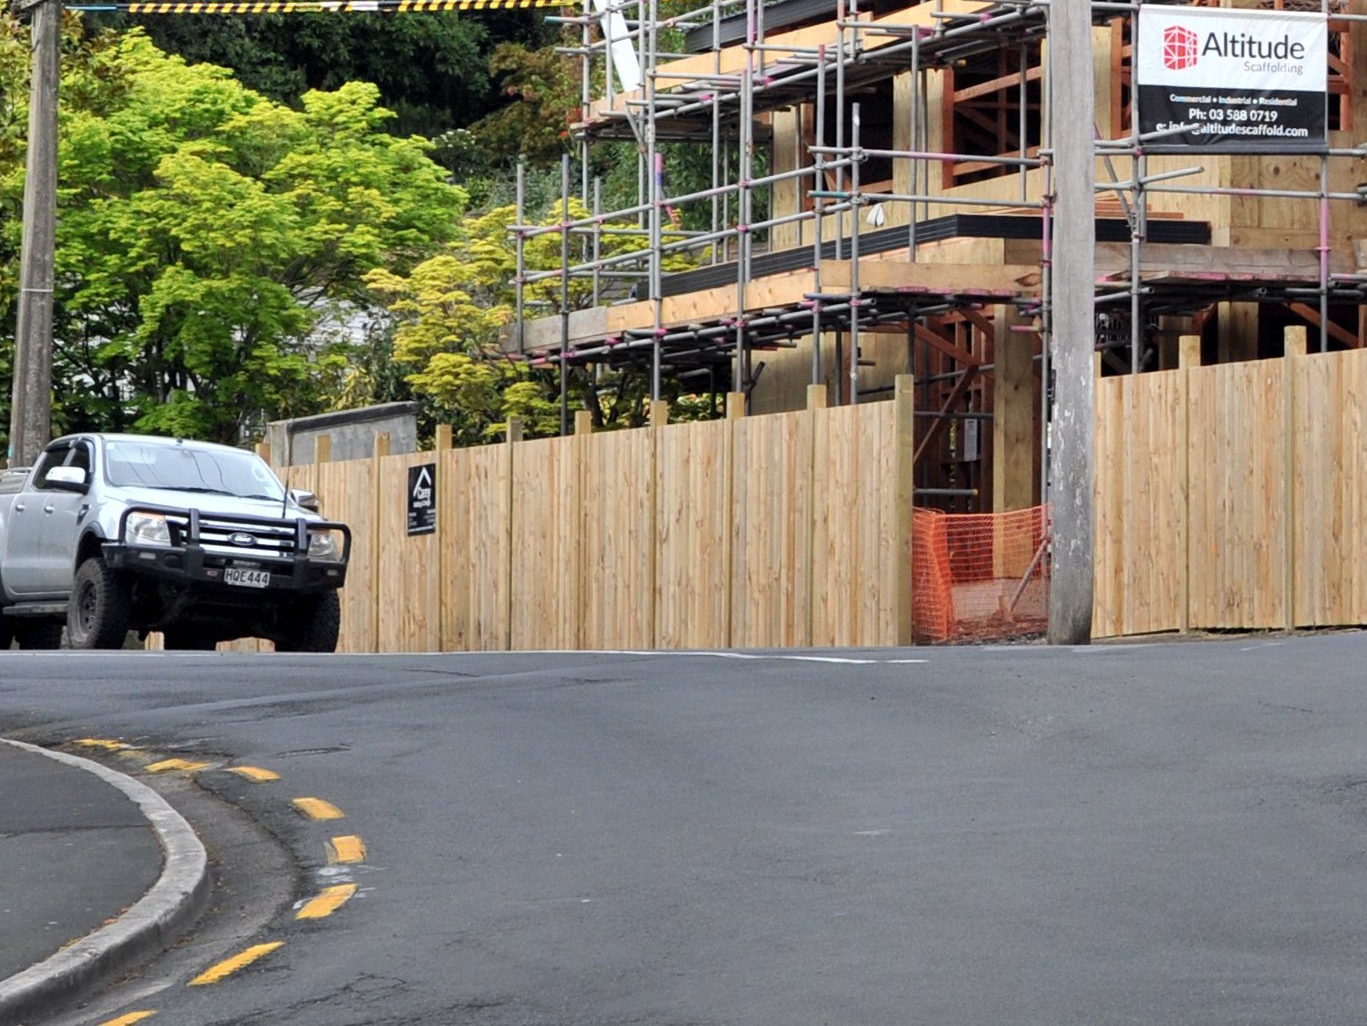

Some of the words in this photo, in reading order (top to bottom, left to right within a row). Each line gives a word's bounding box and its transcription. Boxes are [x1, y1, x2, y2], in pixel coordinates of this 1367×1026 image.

[1202, 32, 1305, 60] Altitude
[1244, 61, 1304, 76] Scaffolding
[1169, 93, 1212, 103] Commercial
[1218, 96, 1252, 104] Industrial
[1258, 96, 1298, 106] Residential
[1188, 108, 1207, 120] Ph:
[1208, 108, 1224, 120] 03
[1226, 109, 1248, 121] 588
[1250, 110, 1278, 122] 0719
[225, 569, 269, 584] HQE444
